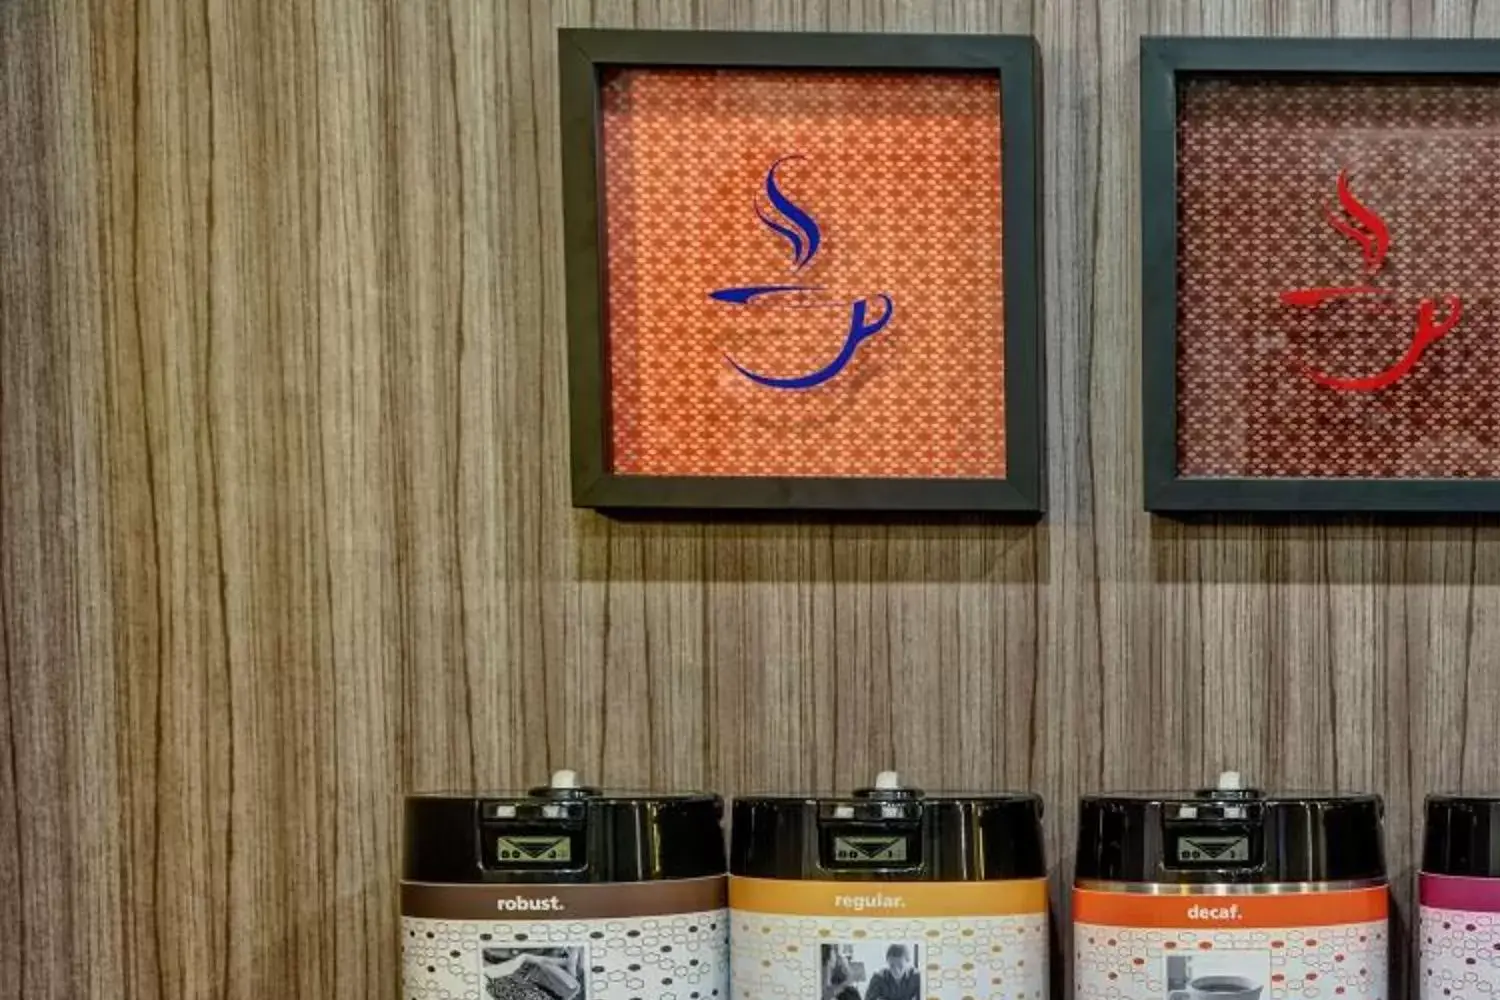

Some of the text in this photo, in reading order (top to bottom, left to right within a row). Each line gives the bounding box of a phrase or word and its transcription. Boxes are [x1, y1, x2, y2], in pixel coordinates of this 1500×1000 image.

[496, 895, 565, 911] robust.
[834, 892, 906, 911] regular.
[1187, 903, 1243, 920] decaf.
